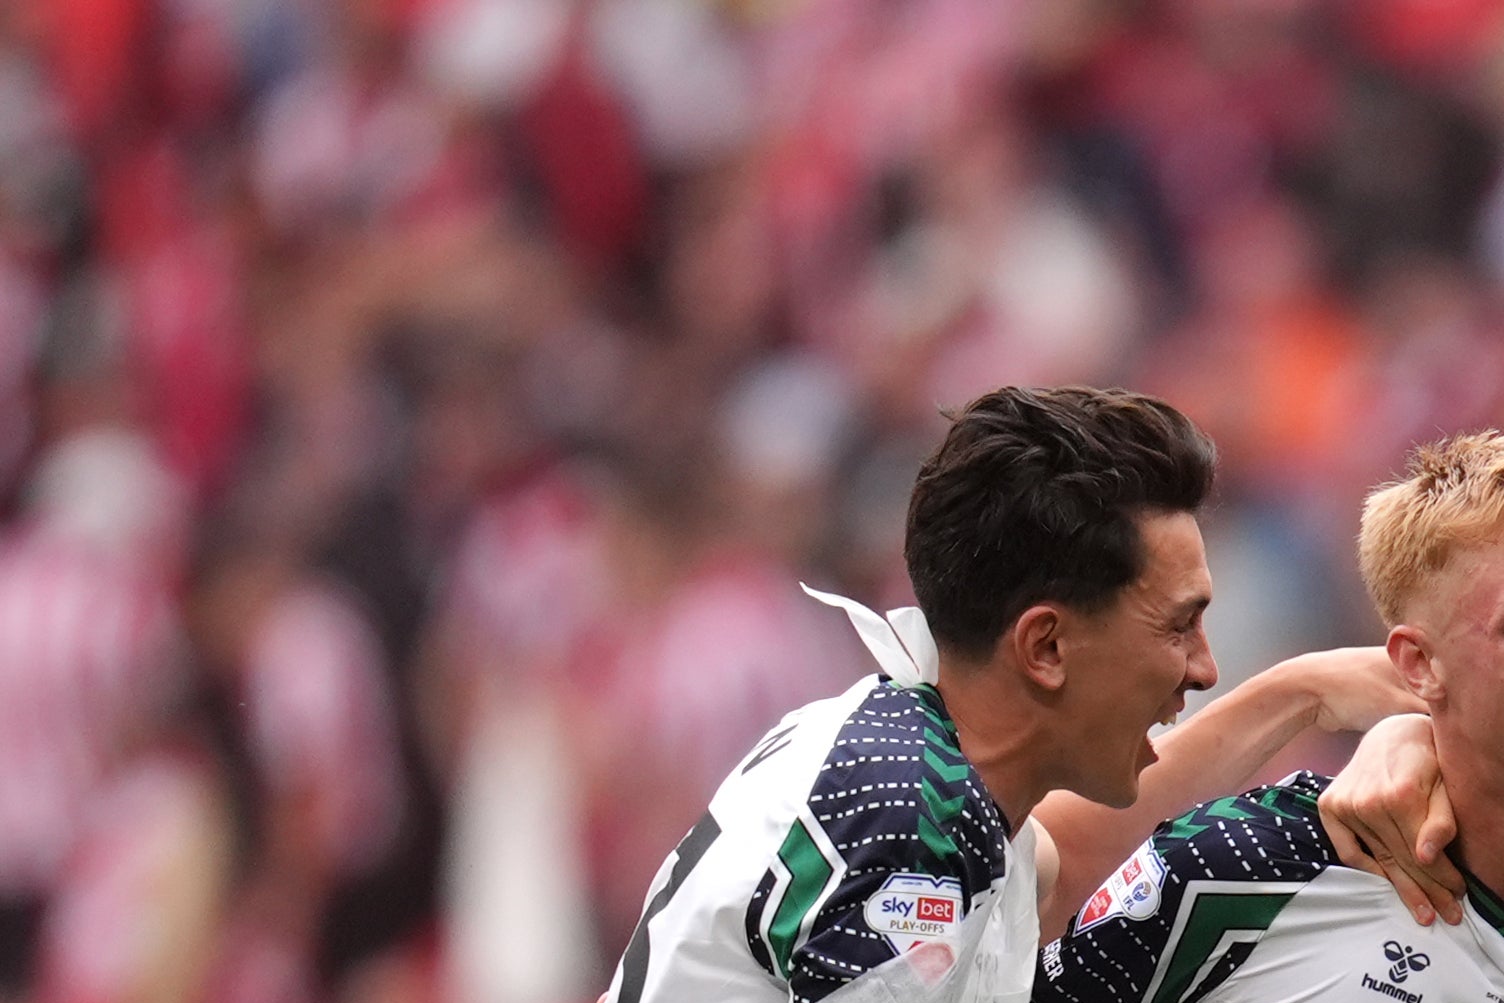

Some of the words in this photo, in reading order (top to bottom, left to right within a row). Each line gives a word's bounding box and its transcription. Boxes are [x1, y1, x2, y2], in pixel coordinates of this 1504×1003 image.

[882, 897, 914, 917] sky
[921, 899, 951, 918] bet
[890, 920, 945, 934] PLAY-OFFS
